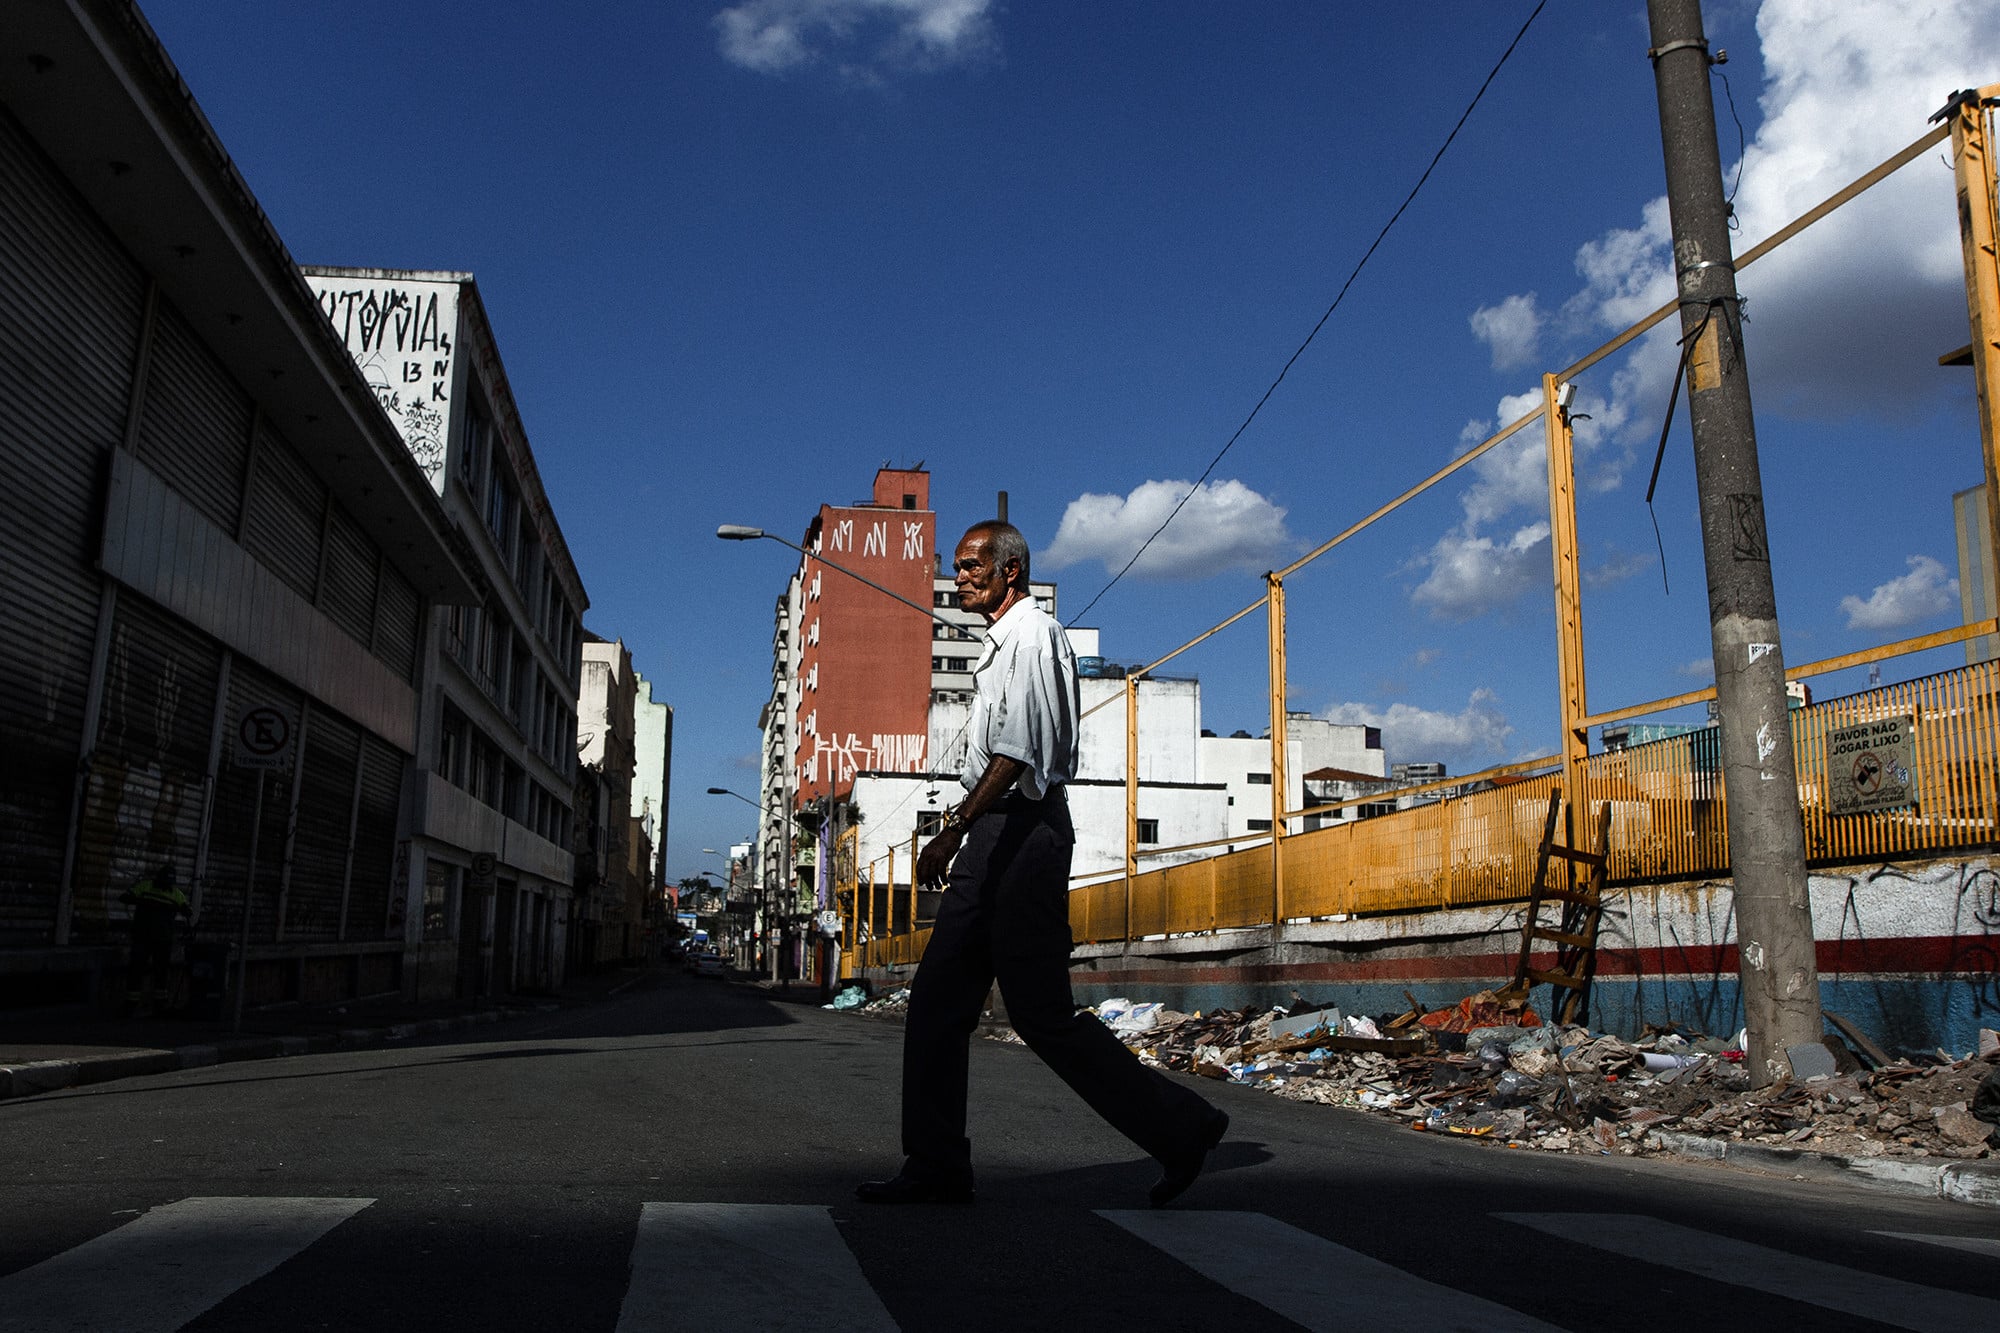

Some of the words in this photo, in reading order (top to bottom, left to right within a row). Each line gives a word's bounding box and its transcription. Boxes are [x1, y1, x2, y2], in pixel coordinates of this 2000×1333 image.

[402, 361, 422, 383] 13
[1834, 728, 1869, 743] FAVOR
[1872, 722, 1897, 735] NÃO
[1833, 741, 1870, 756] JOGAR
[1873, 734, 1900, 748] LIXO
